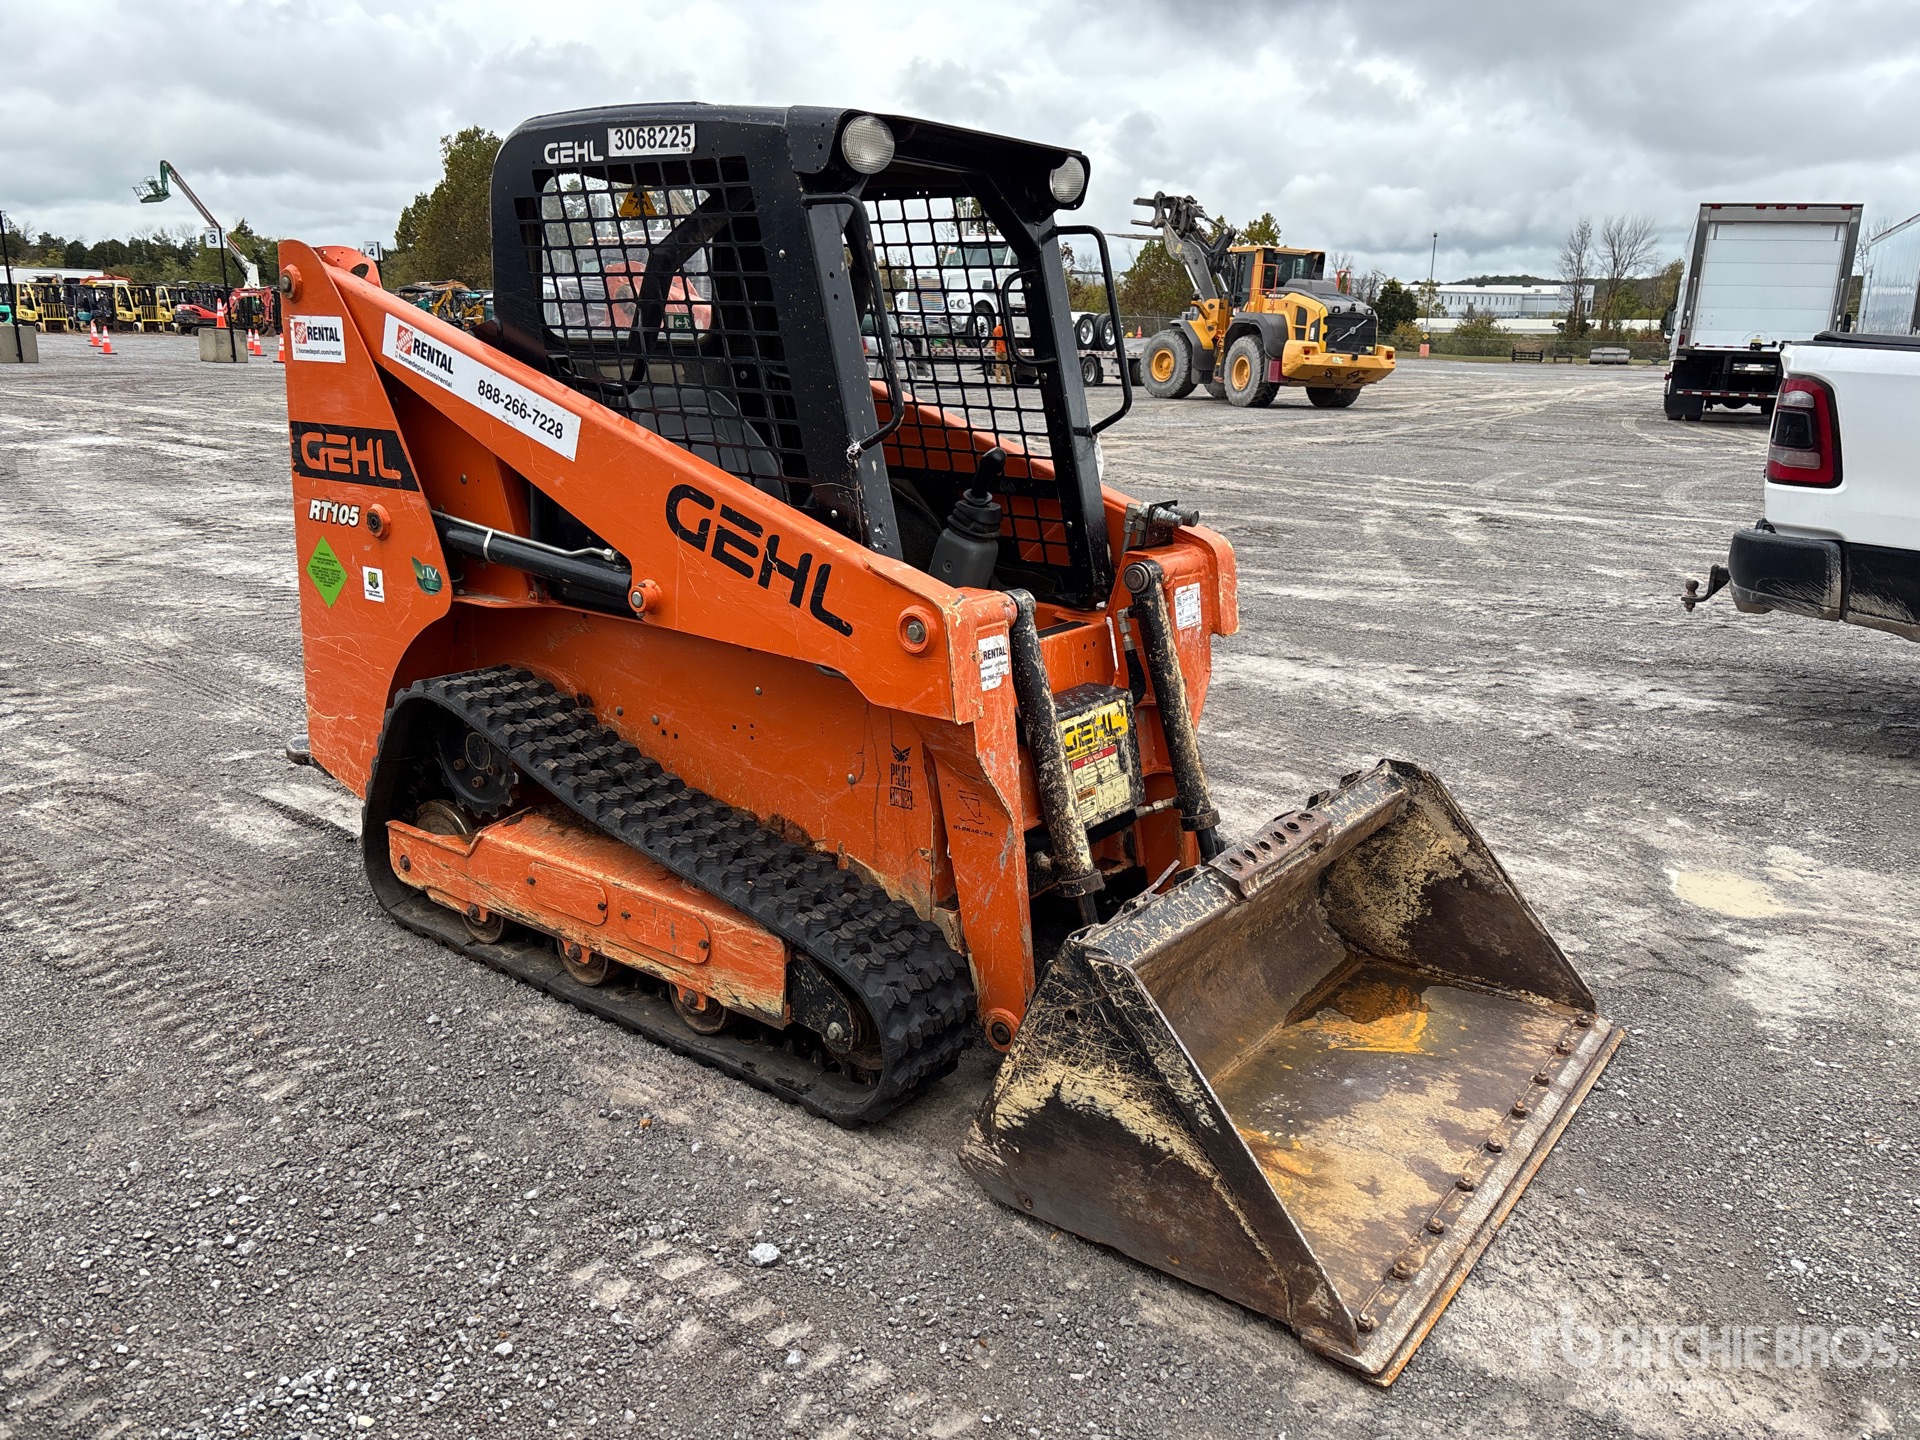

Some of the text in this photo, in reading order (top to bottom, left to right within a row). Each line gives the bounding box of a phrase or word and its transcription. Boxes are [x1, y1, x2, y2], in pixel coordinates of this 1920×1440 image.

[614, 125, 692, 151] 3068225
[543, 139, 604, 165] GEHL
[209, 233, 217, 244] 3
[368, 247, 375, 257] 4
[306, 326, 341, 342] RENTAL
[299, 348, 342, 356] homedepot.com/rental
[412, 337, 454, 375] RENTAL
[398, 353, 453, 388] homedepot.com/rental
[477, 379, 564, 440] 888-266-7228
[301, 431, 402, 480] GEHL
[308, 497, 360, 527] RT105
[665, 483, 853, 637] GEHL
[982, 645, 1007, 661] RENTAL
